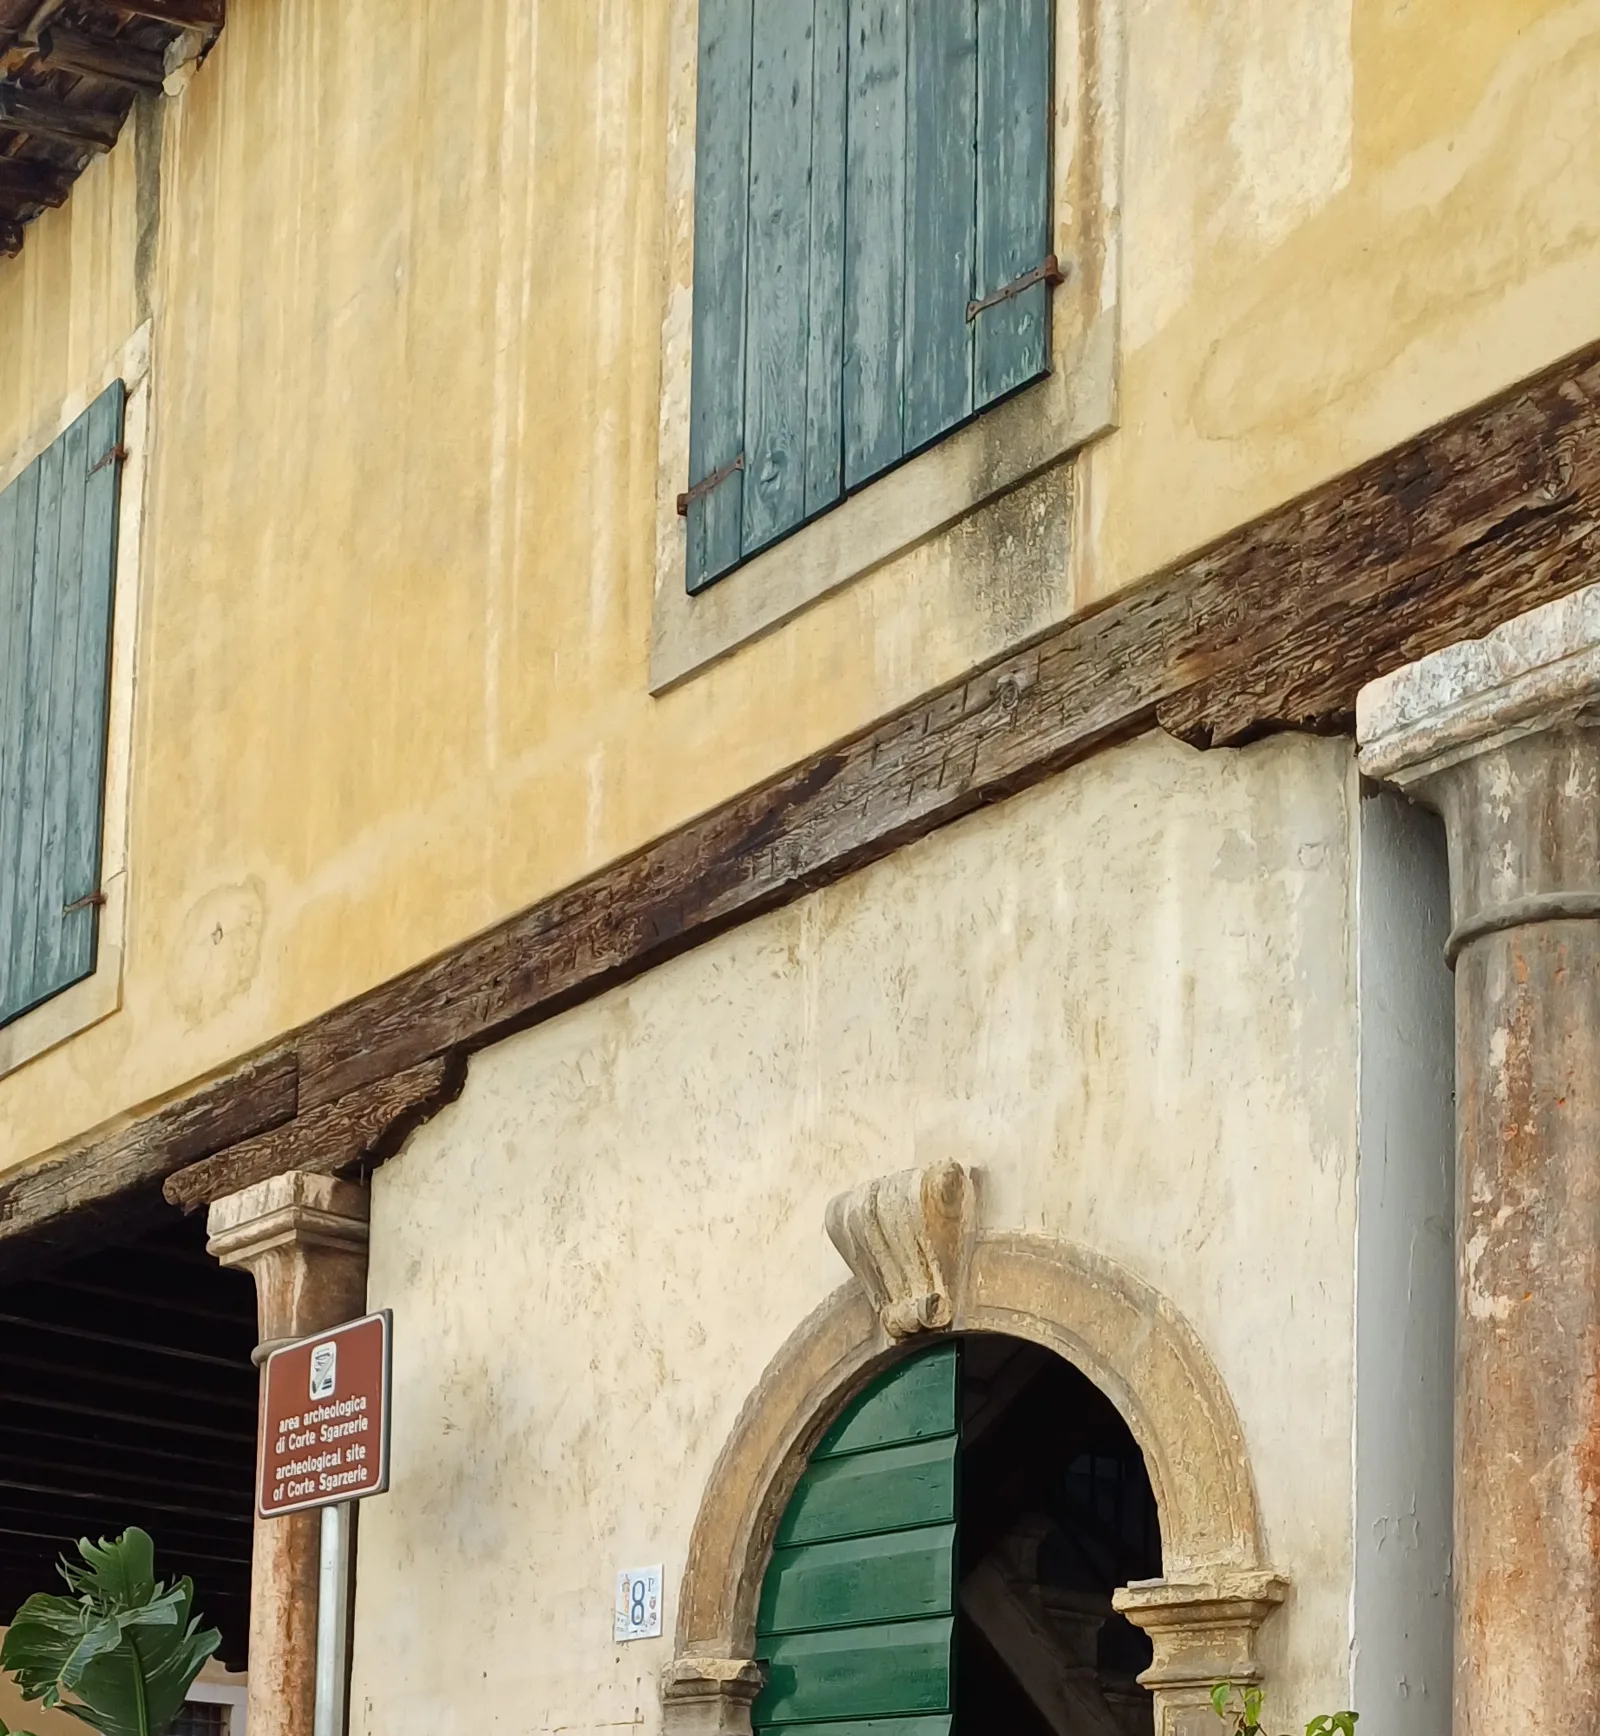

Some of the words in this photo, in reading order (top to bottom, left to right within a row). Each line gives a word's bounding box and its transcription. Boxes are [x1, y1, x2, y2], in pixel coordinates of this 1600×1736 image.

[279, 1415, 299, 1433] area
[303, 1395, 367, 1426] archeologica
[276, 1436, 286, 1454] di
[288, 1430, 316, 1450] Corte
[320, 1414, 368, 1442] Sgarzerie
[276, 1448, 341, 1480] archeological
[346, 1444, 366, 1463] site
[273, 1483, 285, 1501] of
[287, 1477, 315, 1498] Corte
[319, 1464, 367, 1491] Sgarzerie
[631, 1580, 645, 1625] 8
